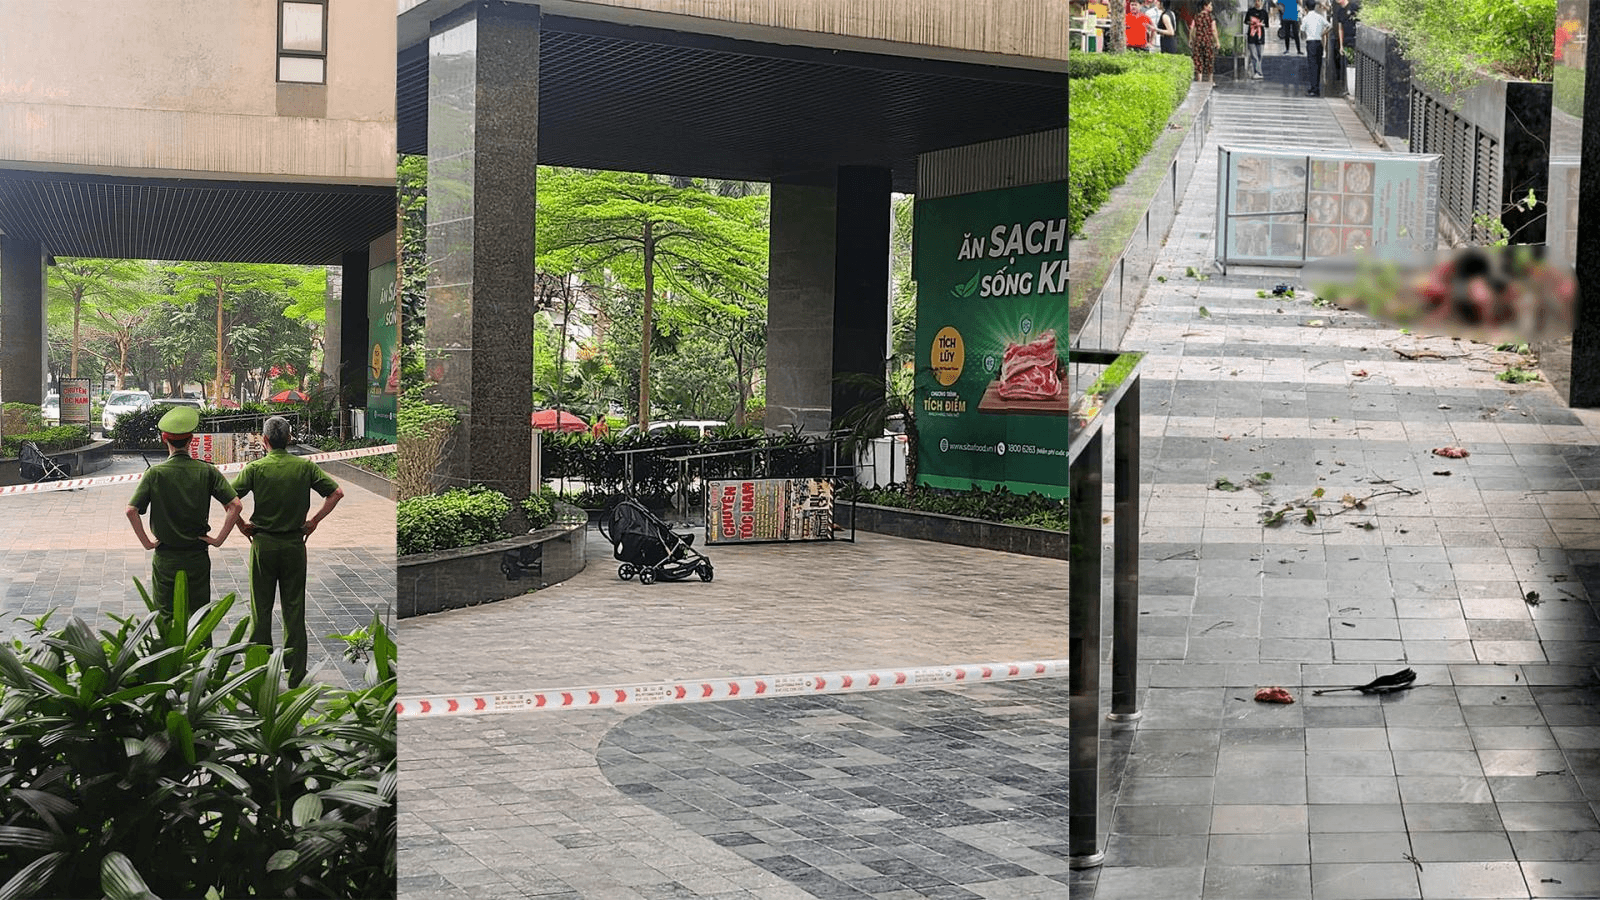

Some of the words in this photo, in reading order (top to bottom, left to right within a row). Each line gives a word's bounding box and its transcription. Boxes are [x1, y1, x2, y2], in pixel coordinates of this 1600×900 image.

[957, 232, 985, 260] ĂN
[988, 218, 1067, 265] SẠCH
[979, 265, 1034, 297] SỐNG
[938, 335, 956, 348] TÍCH
[939, 350, 955, 362] LŨY
[923, 396, 943, 411] TÍCH
[944, 395, 966, 412] ĐIỂM
[741, 482, 755, 512] NAM
[720, 486, 737, 538] CHUYÊN
[739, 515, 754, 539] TÓC
